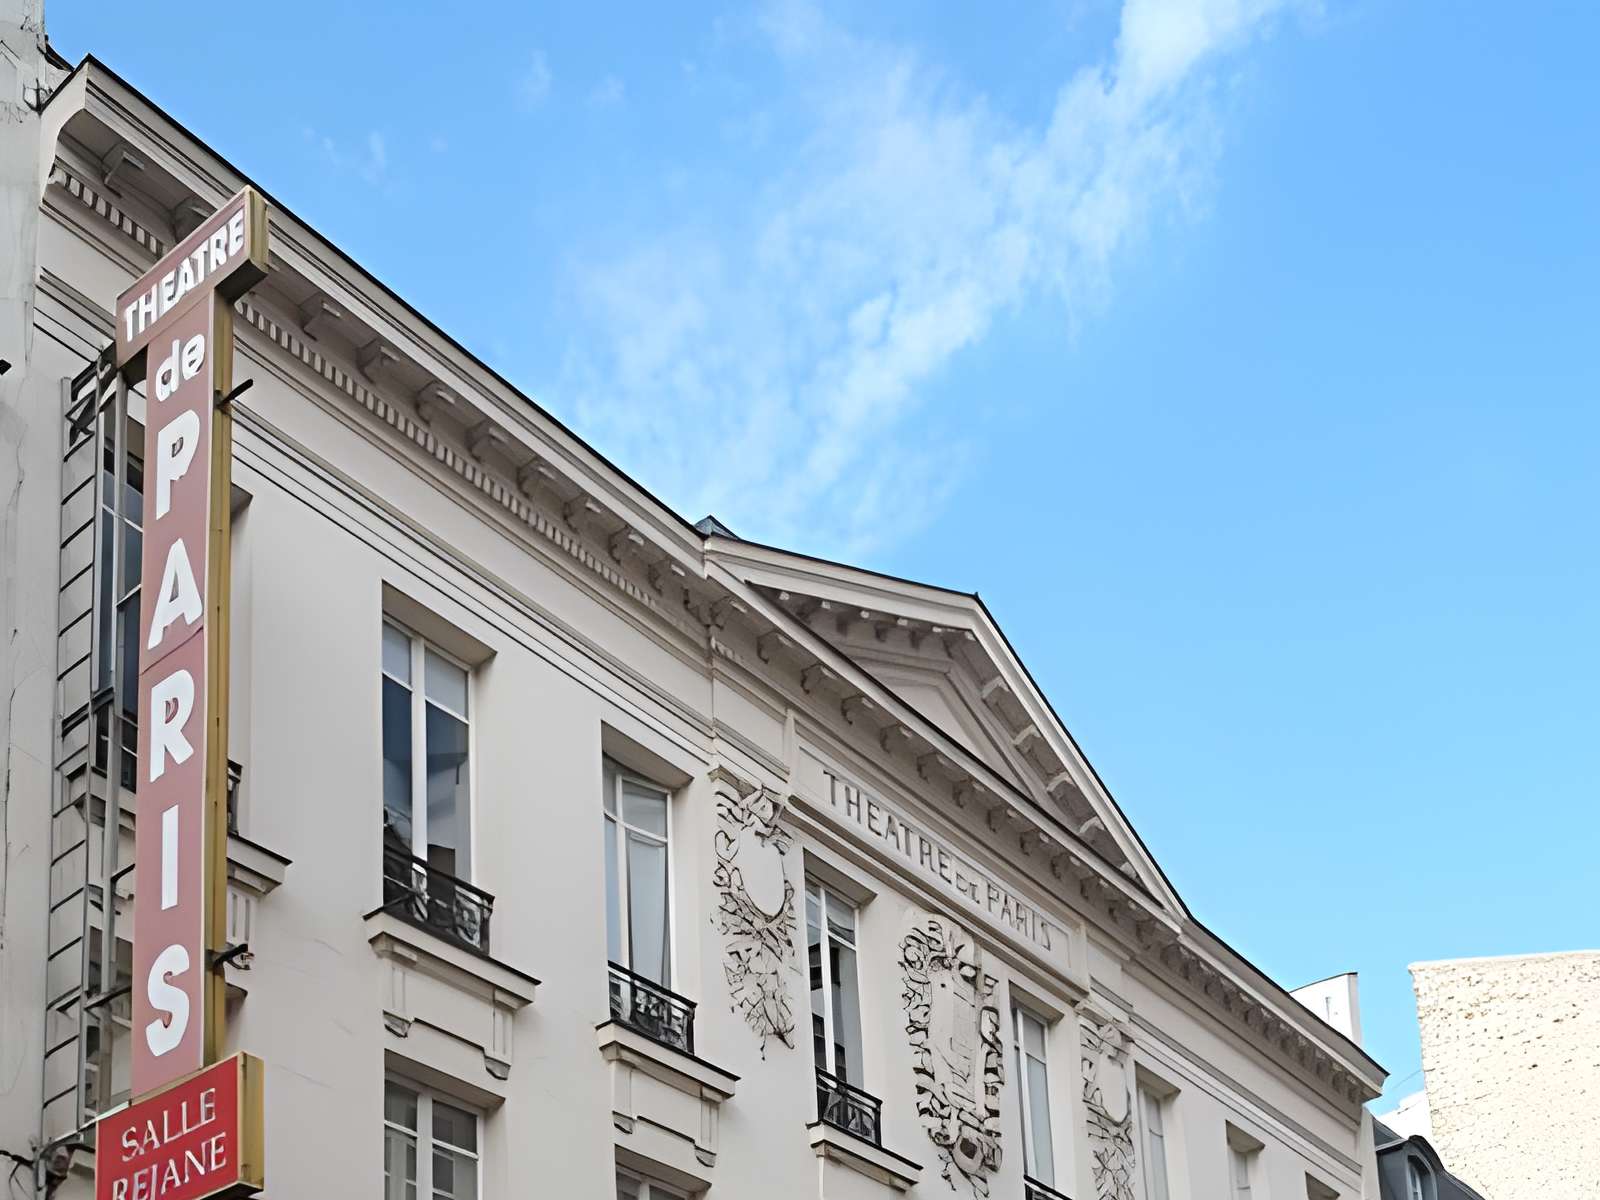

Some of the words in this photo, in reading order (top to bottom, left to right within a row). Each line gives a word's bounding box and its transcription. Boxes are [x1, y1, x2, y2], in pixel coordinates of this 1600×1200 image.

[122, 208, 247, 343] THEATRE
[155, 333, 206, 402] de
[145, 409, 203, 1057] PARIS
[823, 769, 952, 885] THEATRE
[986, 879, 1052, 952] PARIS
[121, 1087, 217, 1163] SALLE
